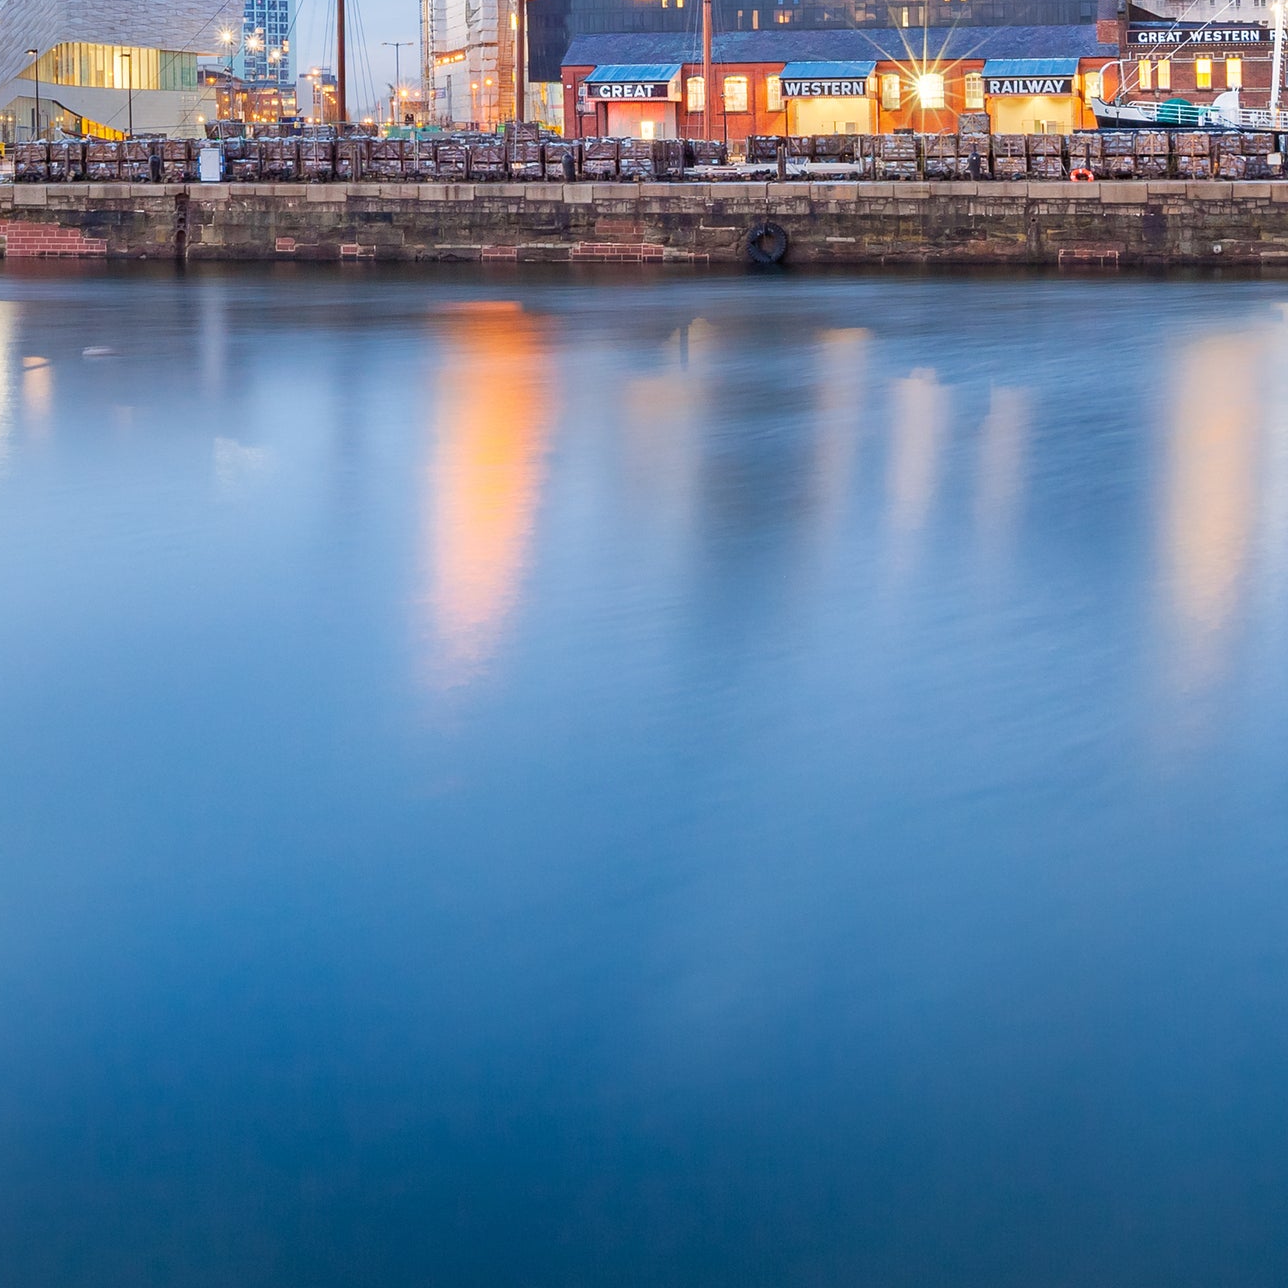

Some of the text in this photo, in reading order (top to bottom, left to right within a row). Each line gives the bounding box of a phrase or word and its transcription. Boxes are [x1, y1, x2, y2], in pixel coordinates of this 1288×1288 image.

[1137, 31, 1183, 43] GREAT
[1189, 29, 1260, 42] WESTERN
[599, 84, 655, 98] GREAT
[784, 81, 864, 96] WESTERN
[989, 79, 1065, 94] RAILWAY
